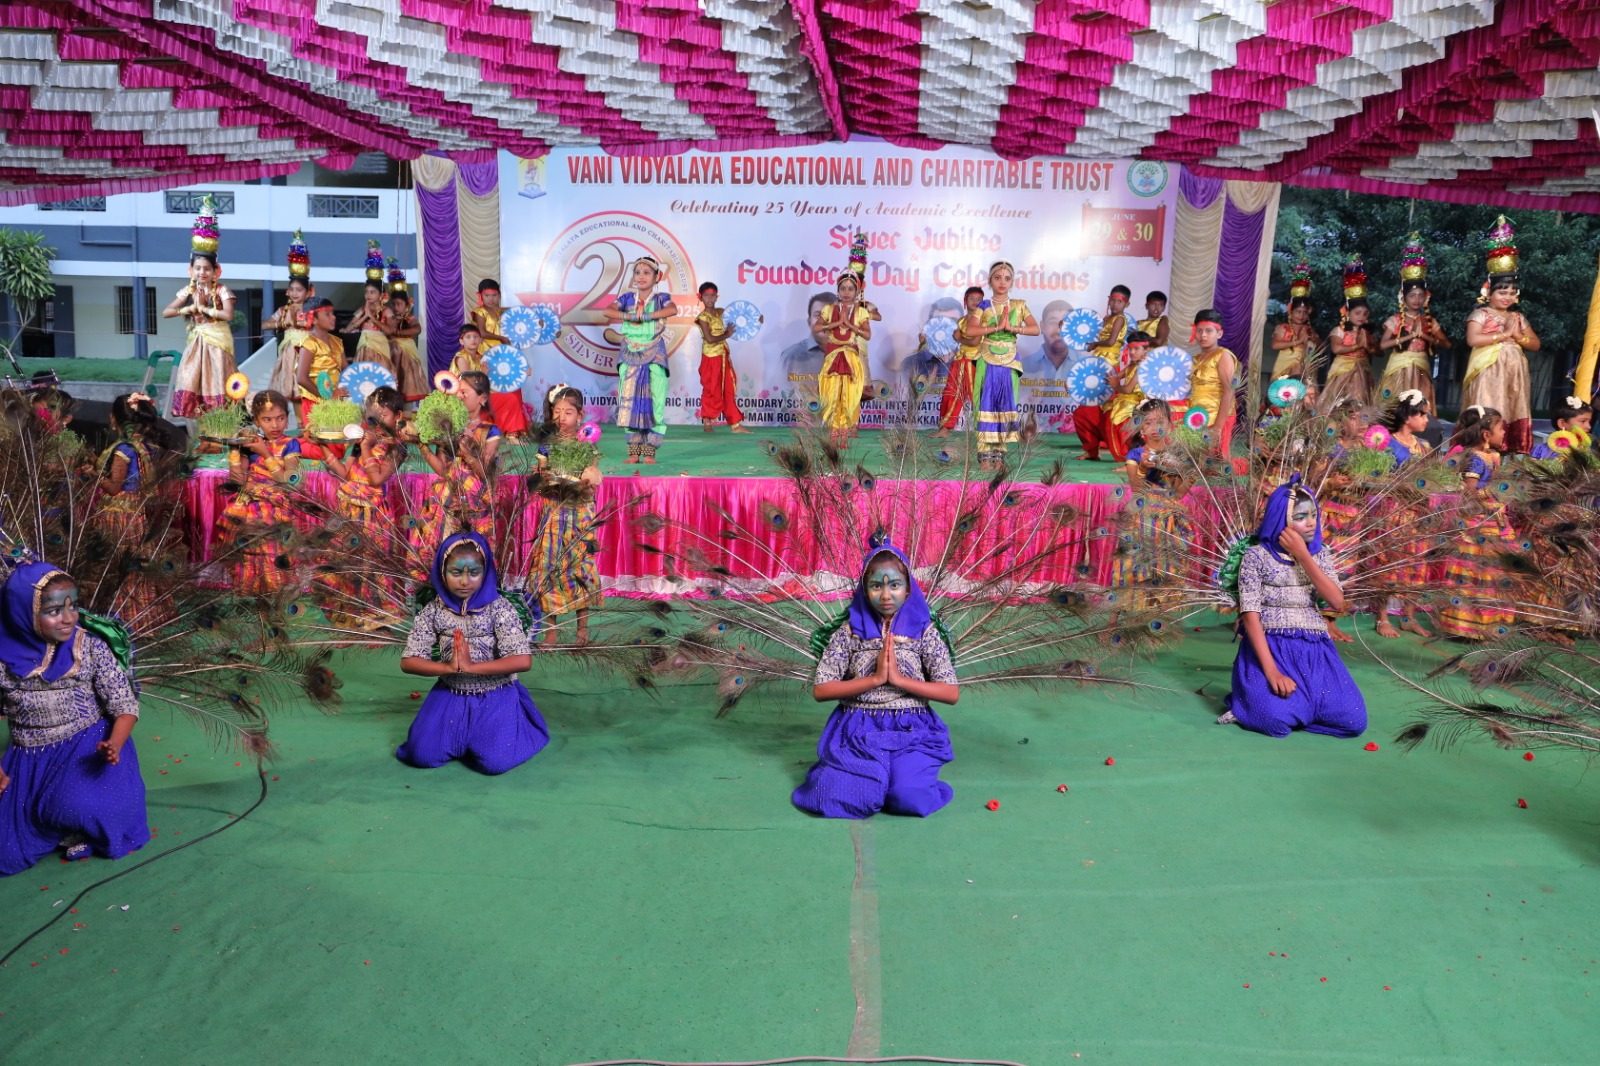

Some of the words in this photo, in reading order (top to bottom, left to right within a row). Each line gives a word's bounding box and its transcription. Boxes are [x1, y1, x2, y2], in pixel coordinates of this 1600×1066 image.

[567, 155, 613, 184] VANI
[620, 155, 724, 184] VIDYALAYA
[731, 156, 866, 186] EDUCATIONAL
[873, 157, 913, 187] AND
[920, 158, 1043, 189] CHARITABLE
[1050, 161, 1114, 191] TRUST
[670, 199, 759, 216] Celebrating
[764, 201, 785, 214] 25
[790, 200, 838, 217] Years
[844, 201, 863, 217] of
[866, 202, 946, 216] Academic
[951, 202, 1032, 218] Excellence
[1112, 213, 1136, 221] JUNE
[579, 220, 630, 236] EDUCATIONAL
[631, 223, 647, 233] AND
[1116, 226, 1128, 240] &
[1132, 221, 1154, 242] 30
[913, 226, 1002, 252] Jubilee
[737, 259, 849, 286] Founder
[870, 261, 920, 292] Day
[932, 262, 1090, 291] Celeations
[676, 304, 701, 318] 025
[567, 334, 614, 368] SILVER
[748, 412, 774, 423] MAIN
